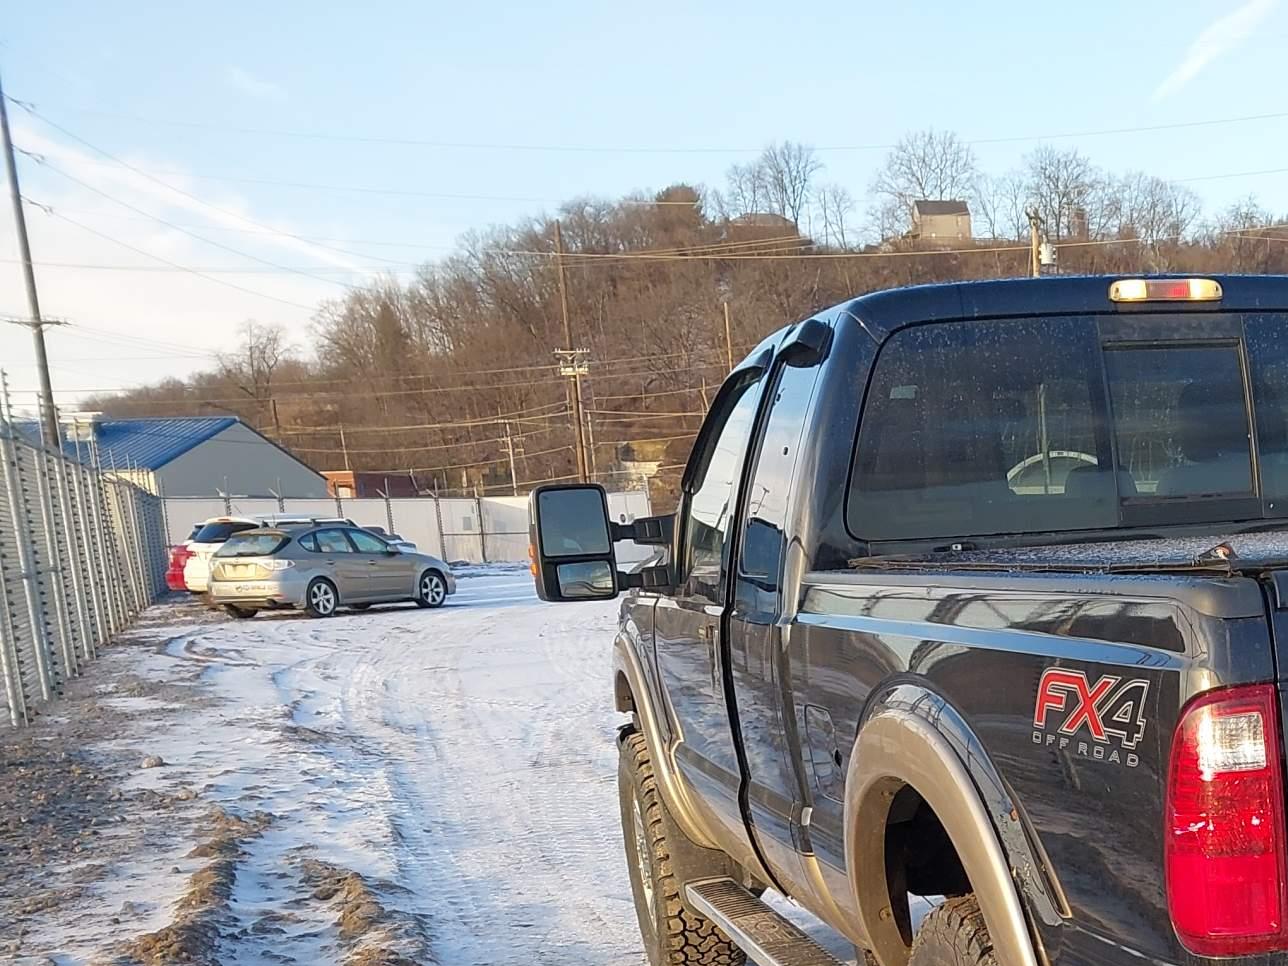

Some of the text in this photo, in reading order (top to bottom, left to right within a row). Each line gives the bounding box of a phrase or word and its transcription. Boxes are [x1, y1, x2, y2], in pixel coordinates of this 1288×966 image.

[1033, 666, 1151, 751] FX4
[1032, 731, 1139, 768] OFF ROAD
